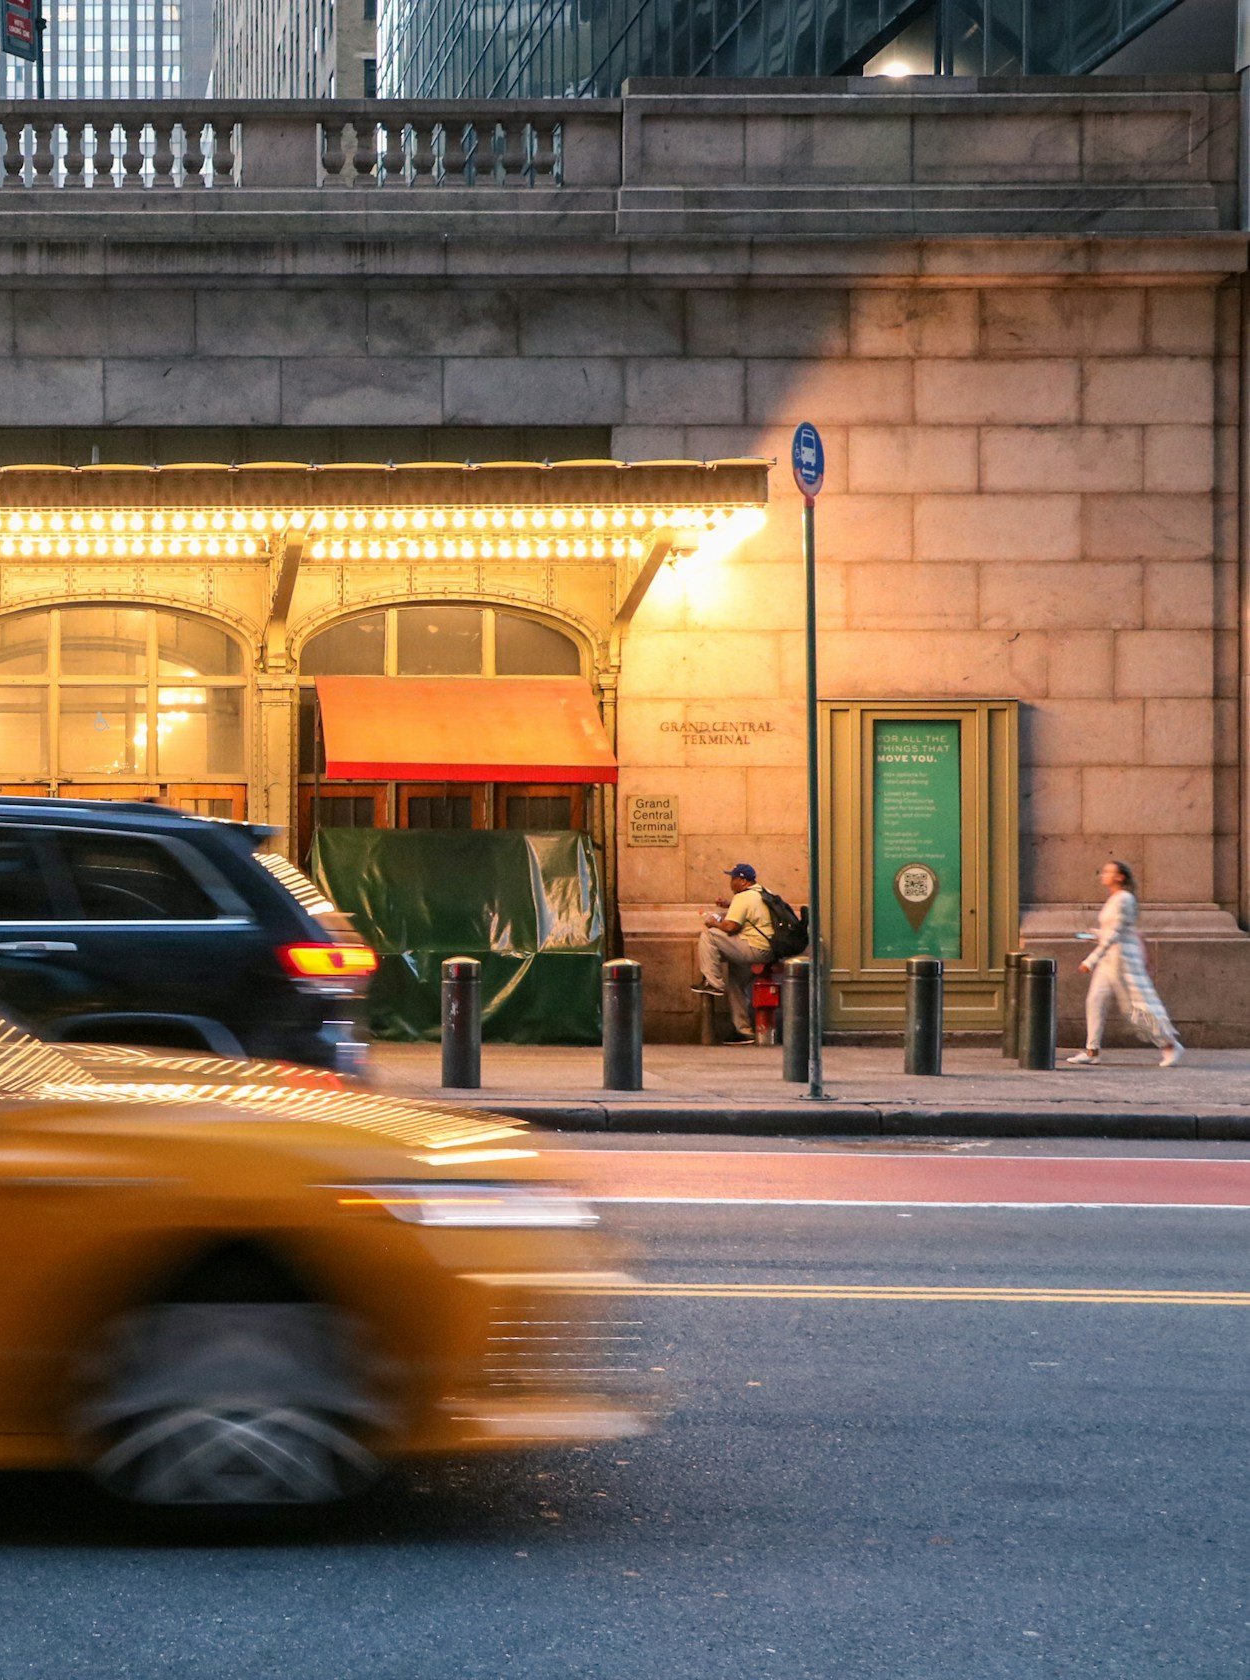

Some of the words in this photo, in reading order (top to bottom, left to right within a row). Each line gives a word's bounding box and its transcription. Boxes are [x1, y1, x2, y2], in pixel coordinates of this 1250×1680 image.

[659, 721, 710, 732] GRAND
[712, 721, 776, 732] CENTRAL
[681, 735, 751, 745] TERMINAL
[877, 735, 898, 743] FOR
[901, 735, 922, 743] ALL
[925, 735, 947, 743] THE
[877, 745, 919, 753] THINGS
[922, 745, 950, 753] THAT
[877, 754, 909, 763] MOVE
[911, 754, 937, 763] YOU.
[635, 798, 670, 808] Grand
[633, 810, 673, 820] Central
[630, 821, 677, 831] Terminal
